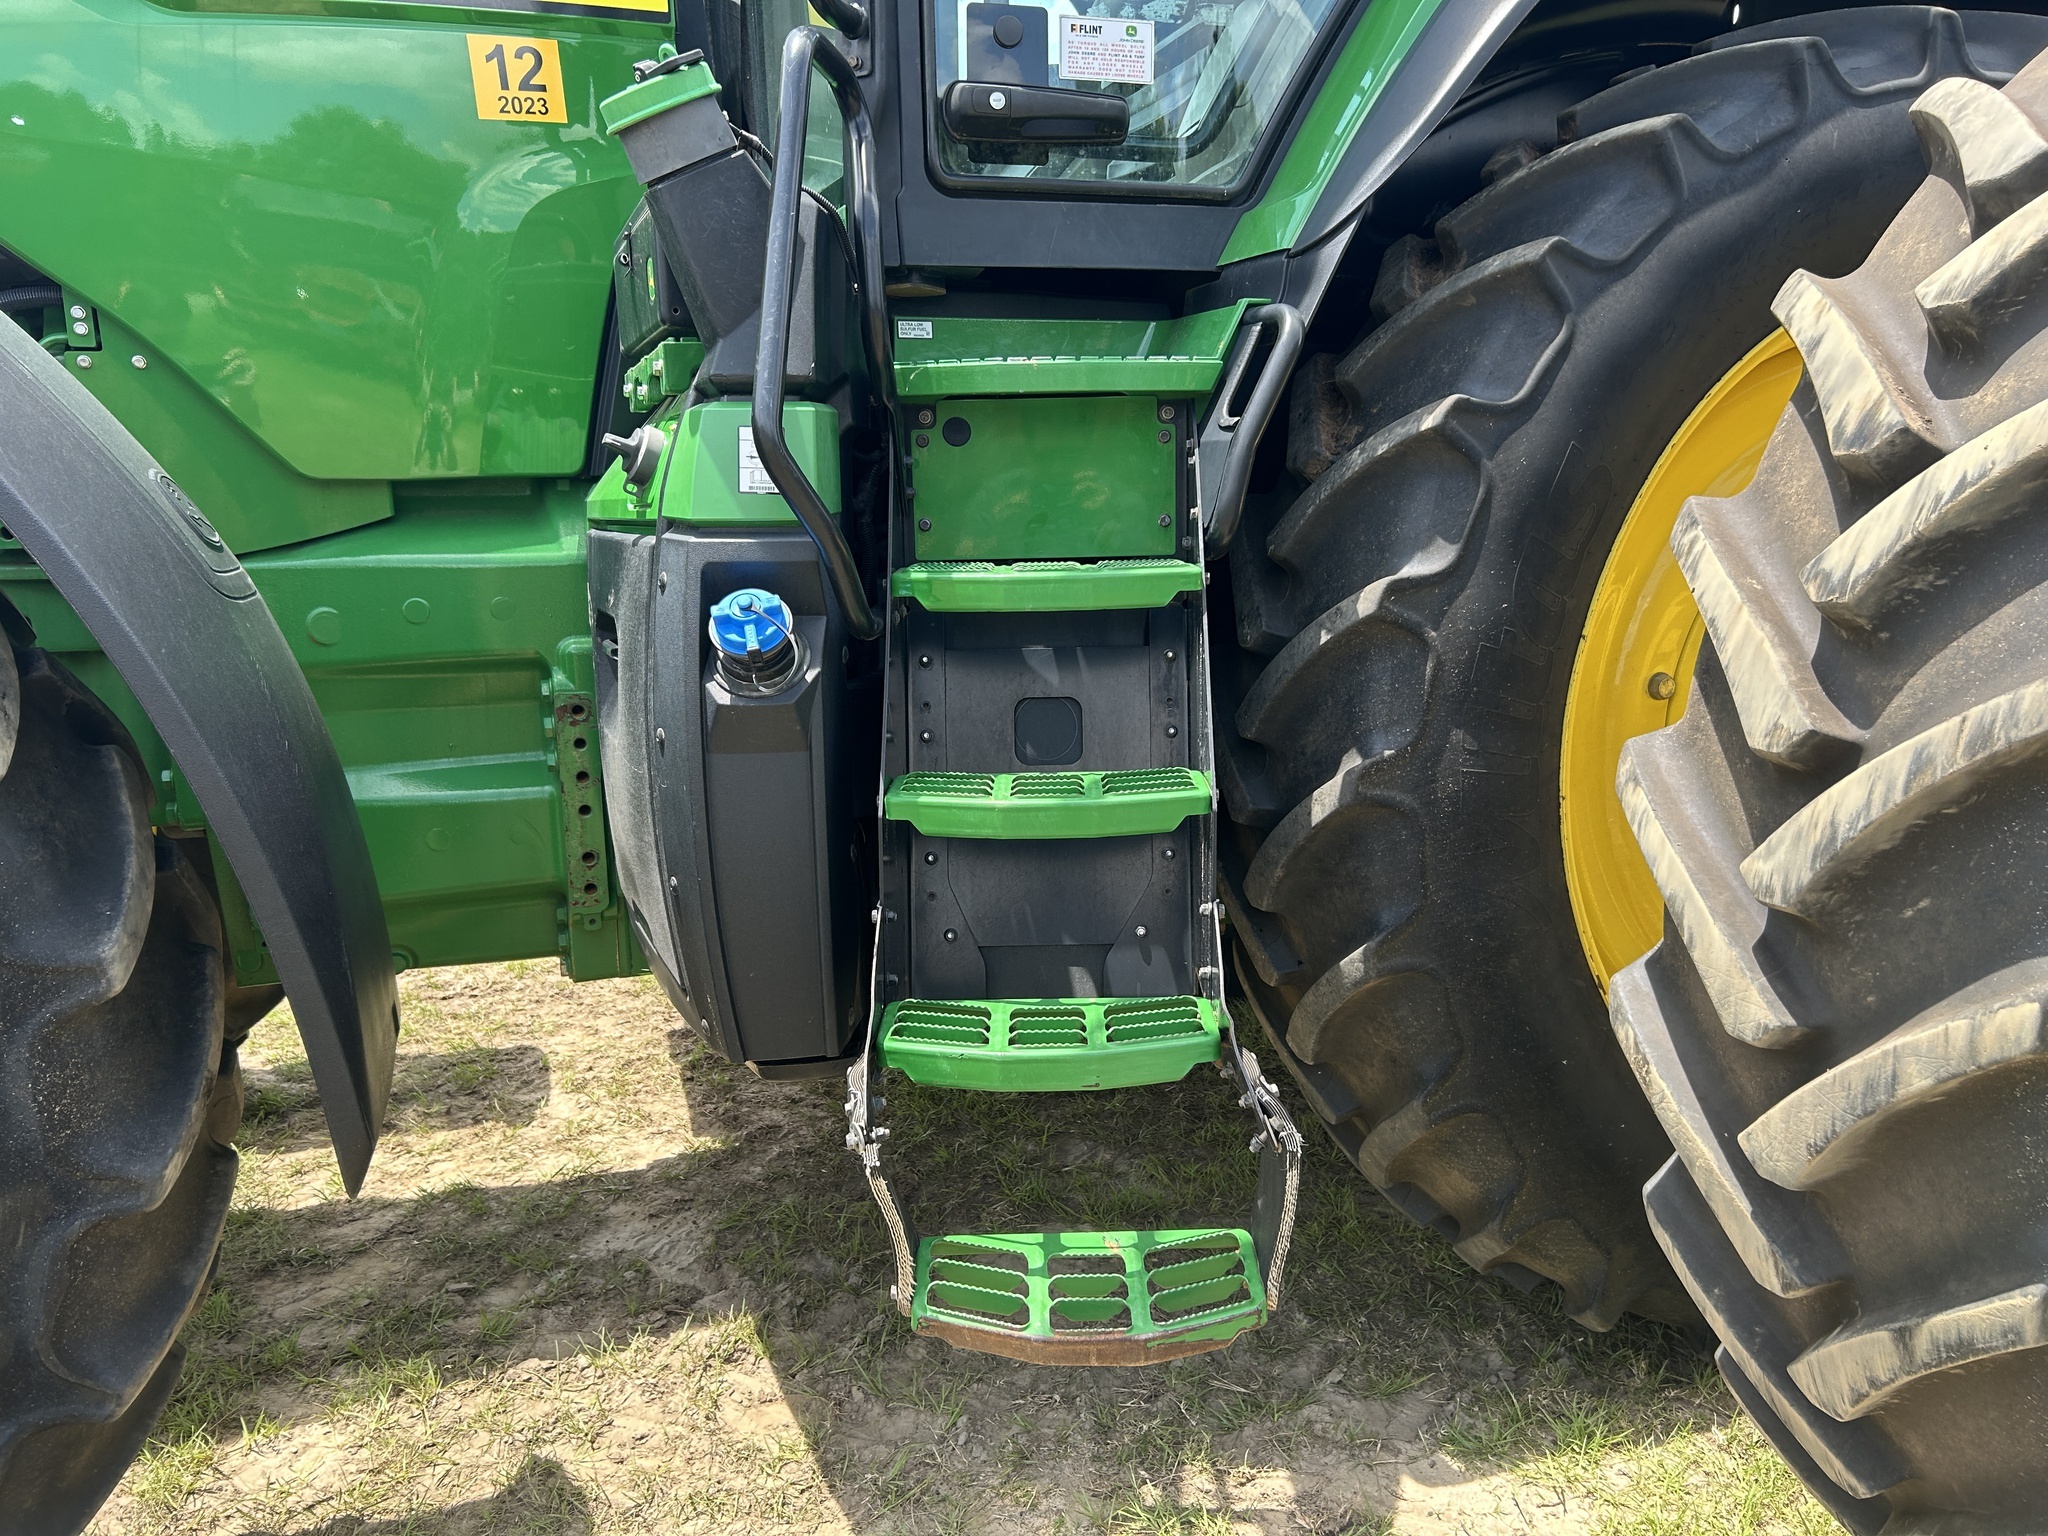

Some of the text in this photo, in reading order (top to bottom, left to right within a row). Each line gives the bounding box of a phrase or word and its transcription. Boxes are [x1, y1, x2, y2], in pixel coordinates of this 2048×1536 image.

[1080, 24, 1102, 34] FLINT
[485, 44, 548, 92] 12
[497, 96, 550, 116] 2023
